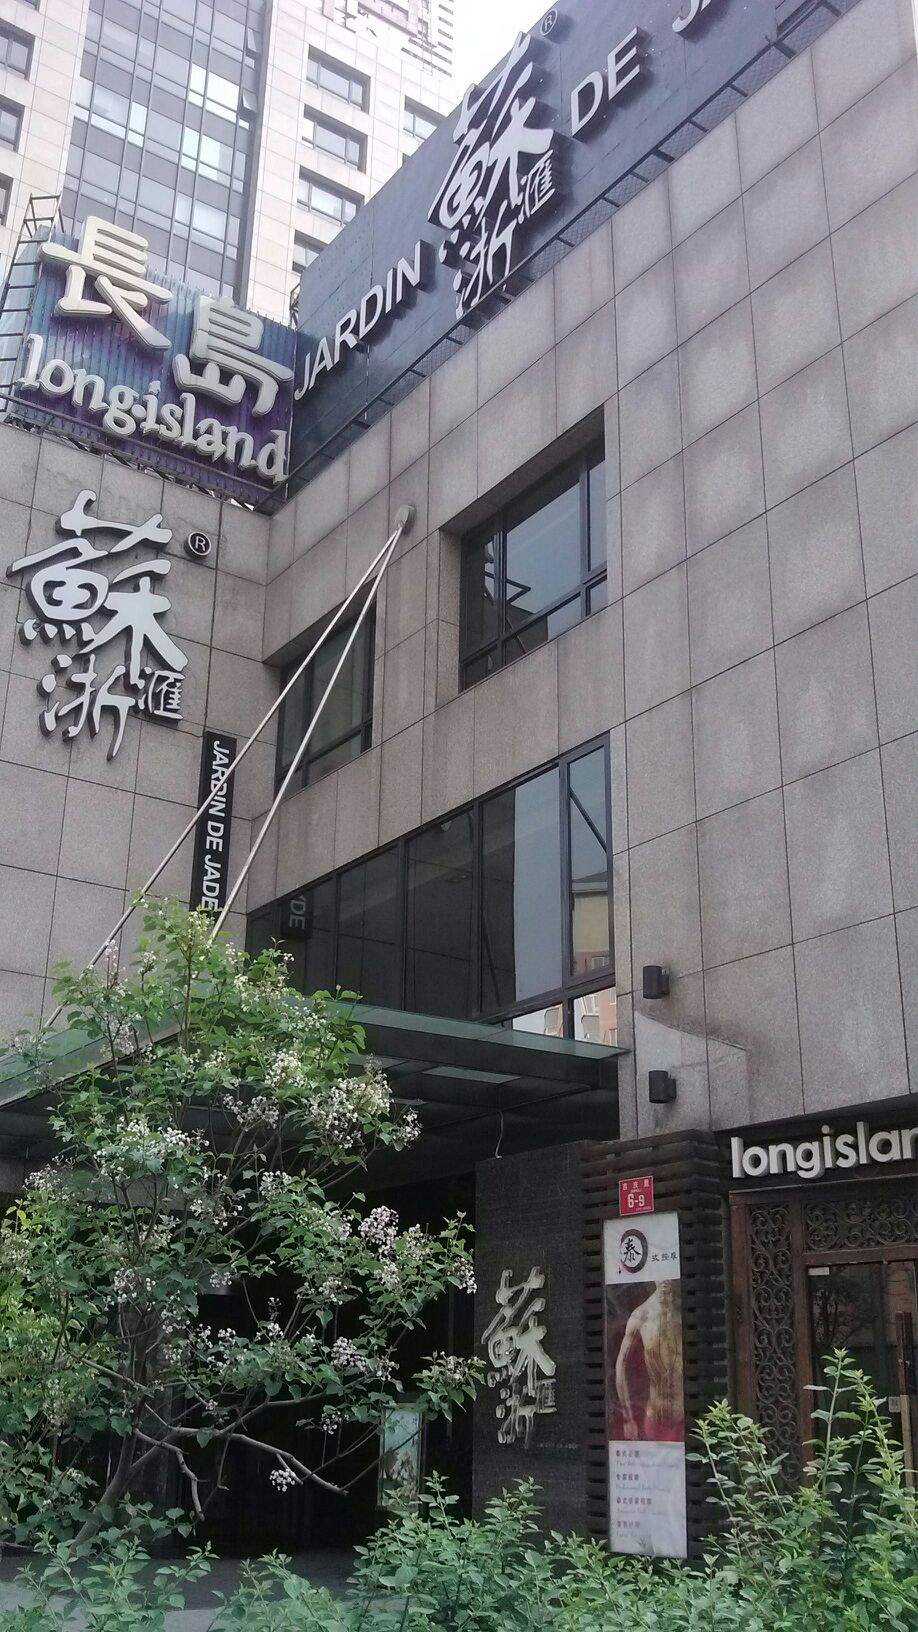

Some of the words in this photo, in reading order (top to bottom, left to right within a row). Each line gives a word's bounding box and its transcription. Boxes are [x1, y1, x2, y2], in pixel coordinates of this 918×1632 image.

[571, 27, 641, 138] DE
[38, 215, 295, 416] 長島
[294, 240, 422, 401] JARDIN
[14, 333, 290, 483] longisland
[208, 740, 231, 817] JARDIN
[201, 854, 224, 911] JADE
[205, 819, 227, 853] DE
[627, 1193, 645, 1208] 6-9
